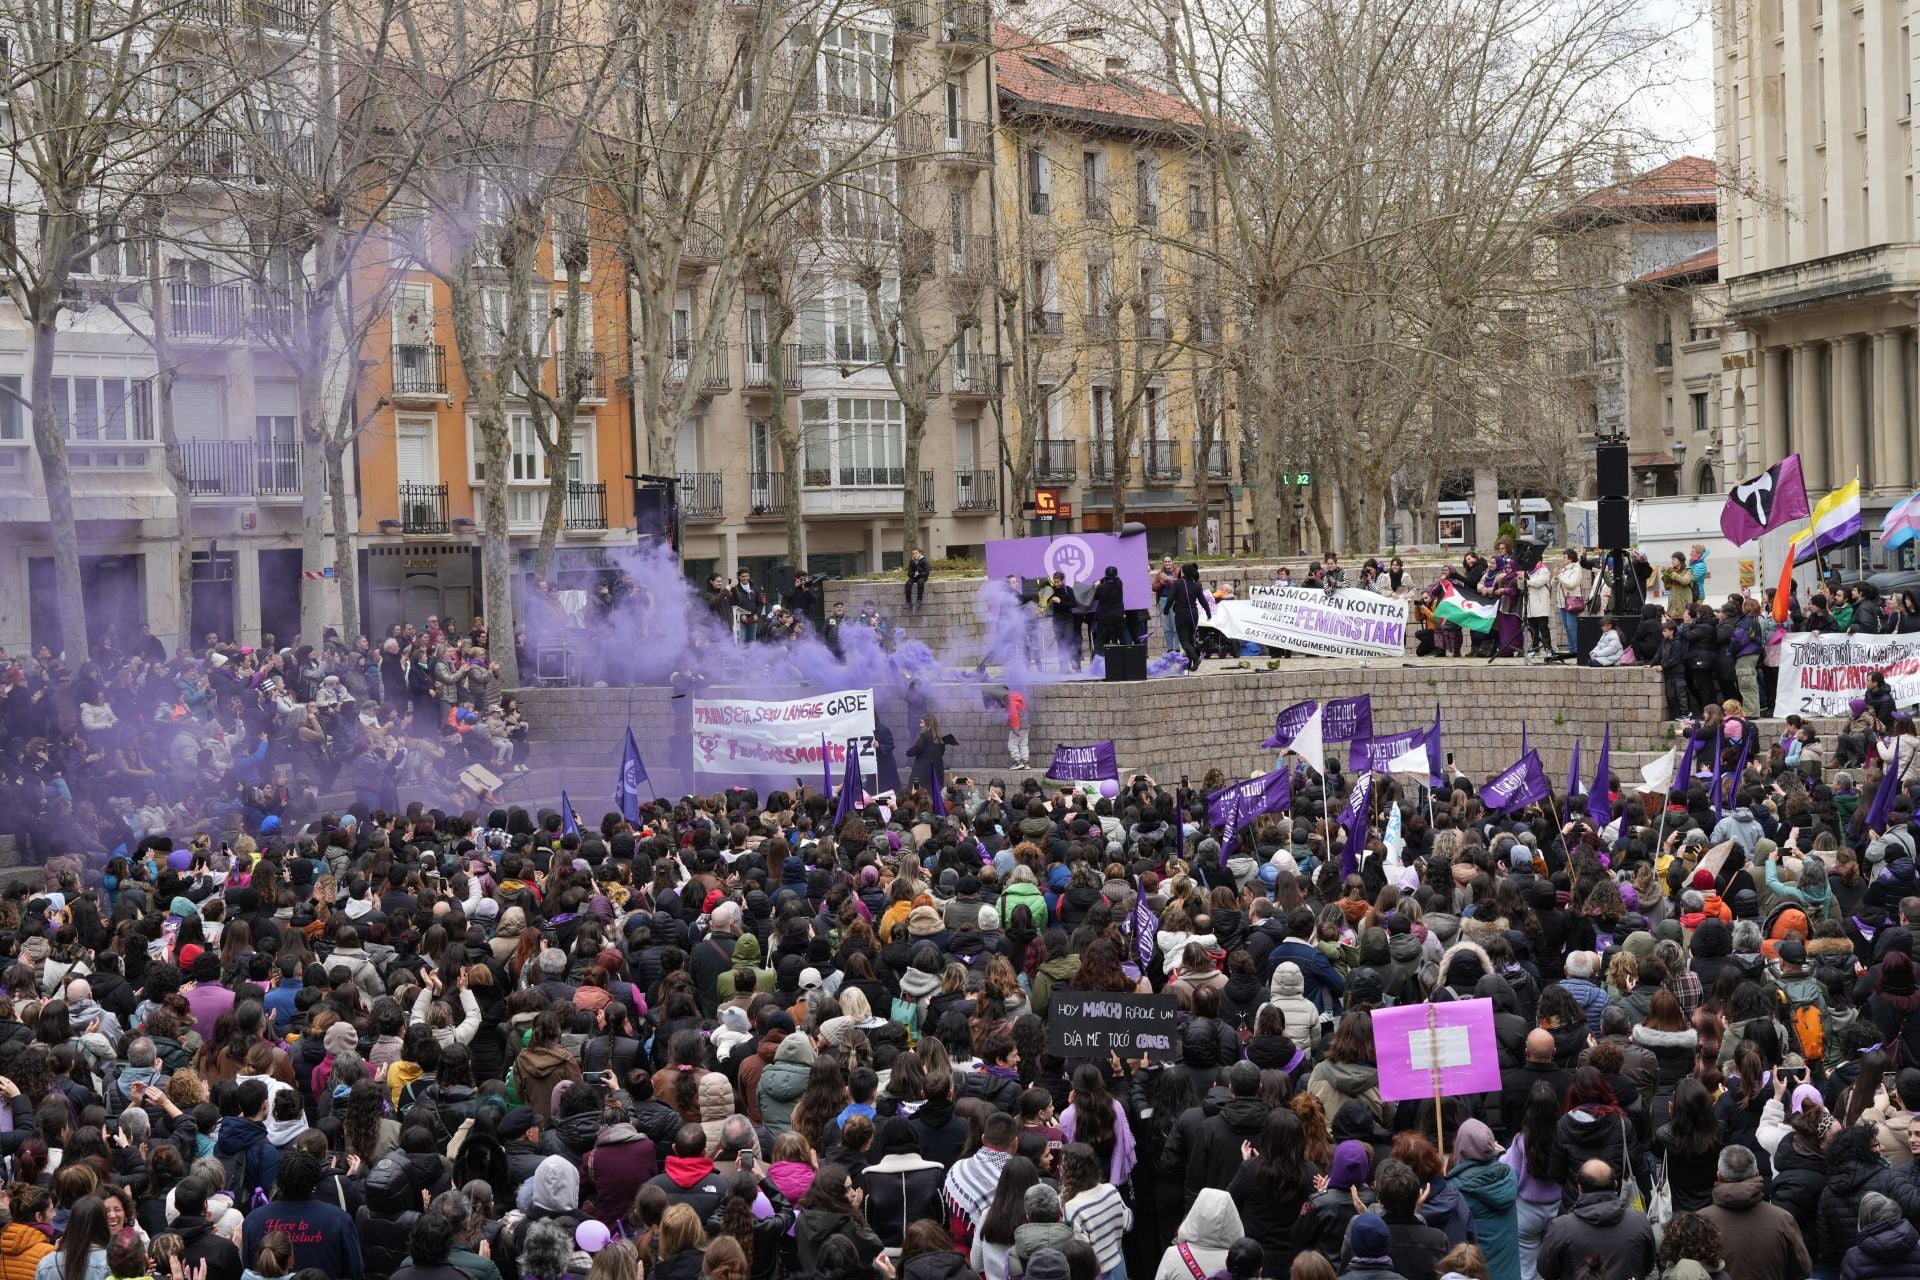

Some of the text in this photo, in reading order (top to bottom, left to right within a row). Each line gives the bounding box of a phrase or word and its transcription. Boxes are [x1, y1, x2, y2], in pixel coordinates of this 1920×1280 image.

[1252, 600, 1298, 613] AUSARDIA ETA
[1346, 599, 1404, 618] KONTRA
[1261, 612, 1295, 624] ALIANTZA
[1295, 605, 1403, 646] FEMINISTAK!
[1245, 628, 1287, 643] GASTEIZKO
[1288, 637, 1343, 654] MUGIMENDU
[827, 695, 868, 716] GABE
[1058, 1000, 1174, 1020] HOY MARCHO PORQUE UN
[1064, 1030, 1082, 1047] DÍA
[1087, 1032, 1102, 1047] ME
[1109, 1030, 1130, 1048] TOCÓ
[264, 1218, 309, 1233] Here to
